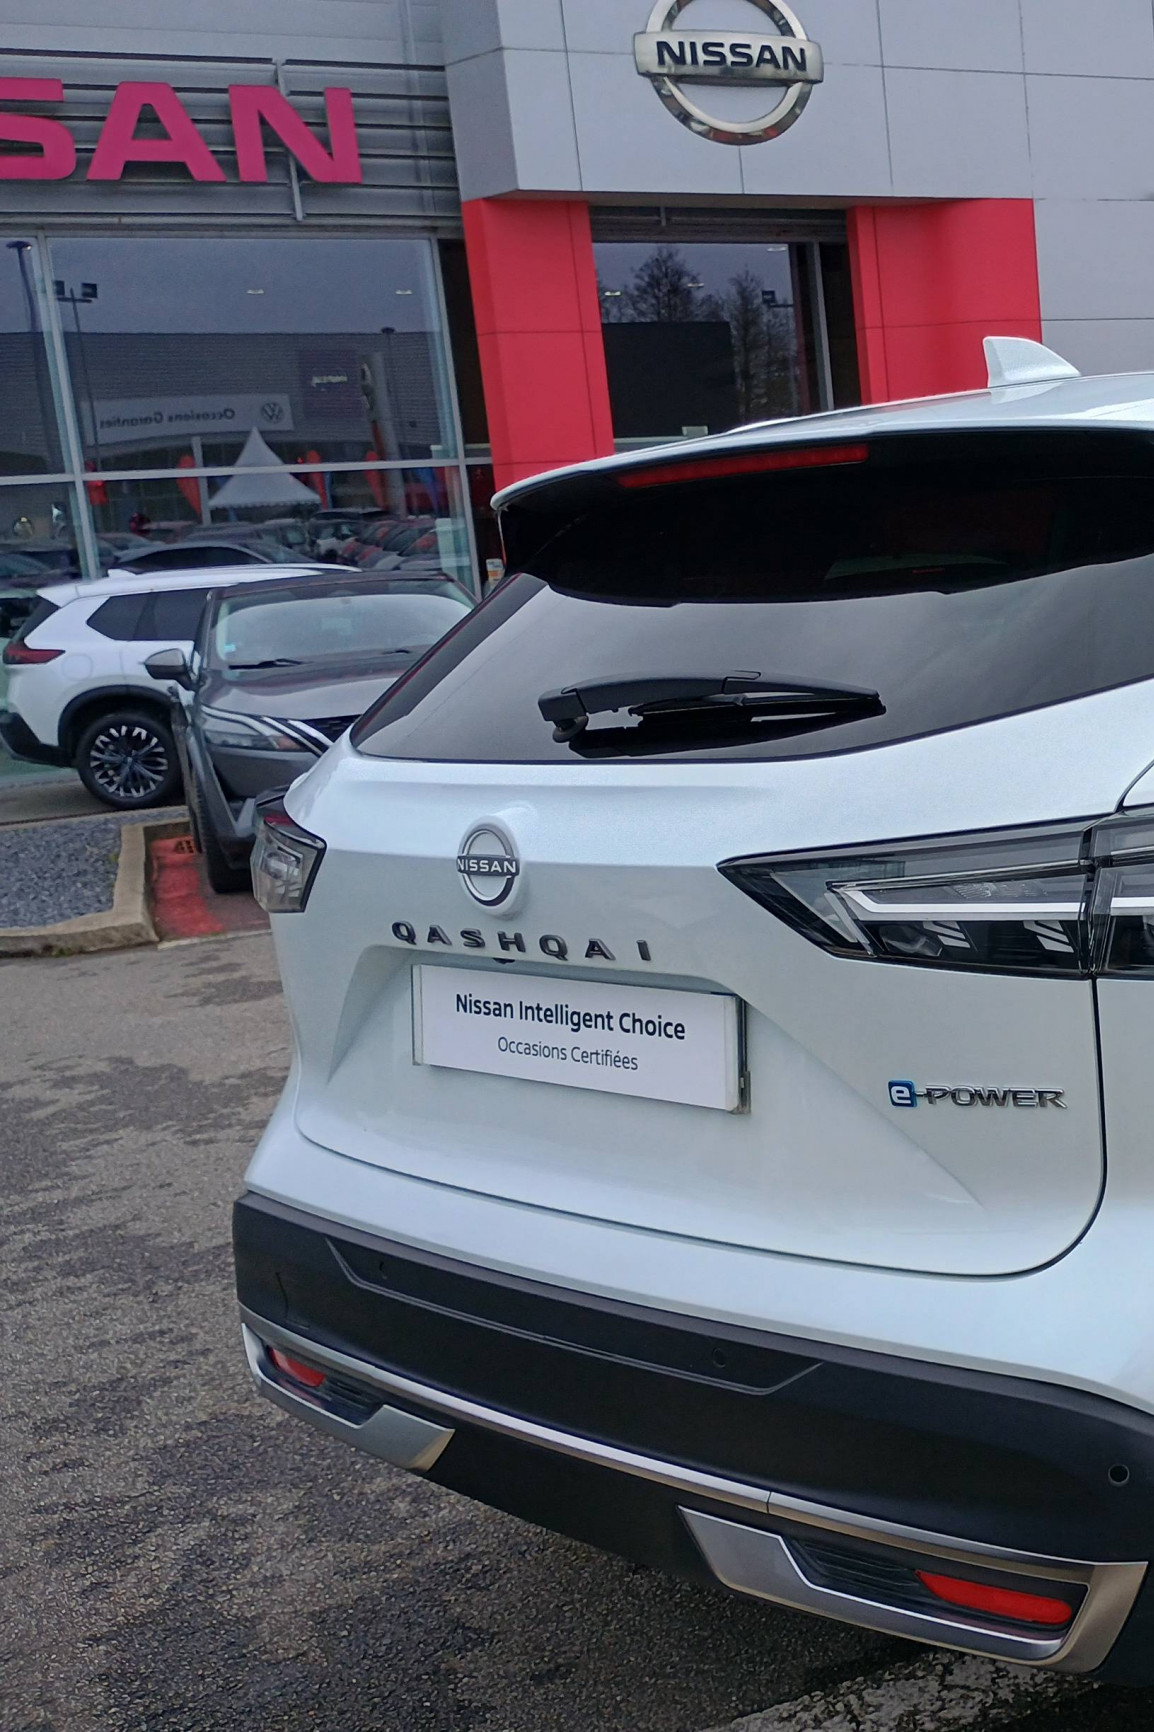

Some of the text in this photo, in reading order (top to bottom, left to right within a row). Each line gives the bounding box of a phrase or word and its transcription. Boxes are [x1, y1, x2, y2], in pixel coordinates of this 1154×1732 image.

[656, 41, 807, 72] NISSAN
[457, 858, 517, 874] NISSAN
[391, 920, 652, 962] QASHQAI
[456, 994, 686, 1040] Nissan Intelligent Choice
[498, 1036, 639, 1071] Occasions Certifiées
[889, 1081, 1067, 1109] e-POWER
